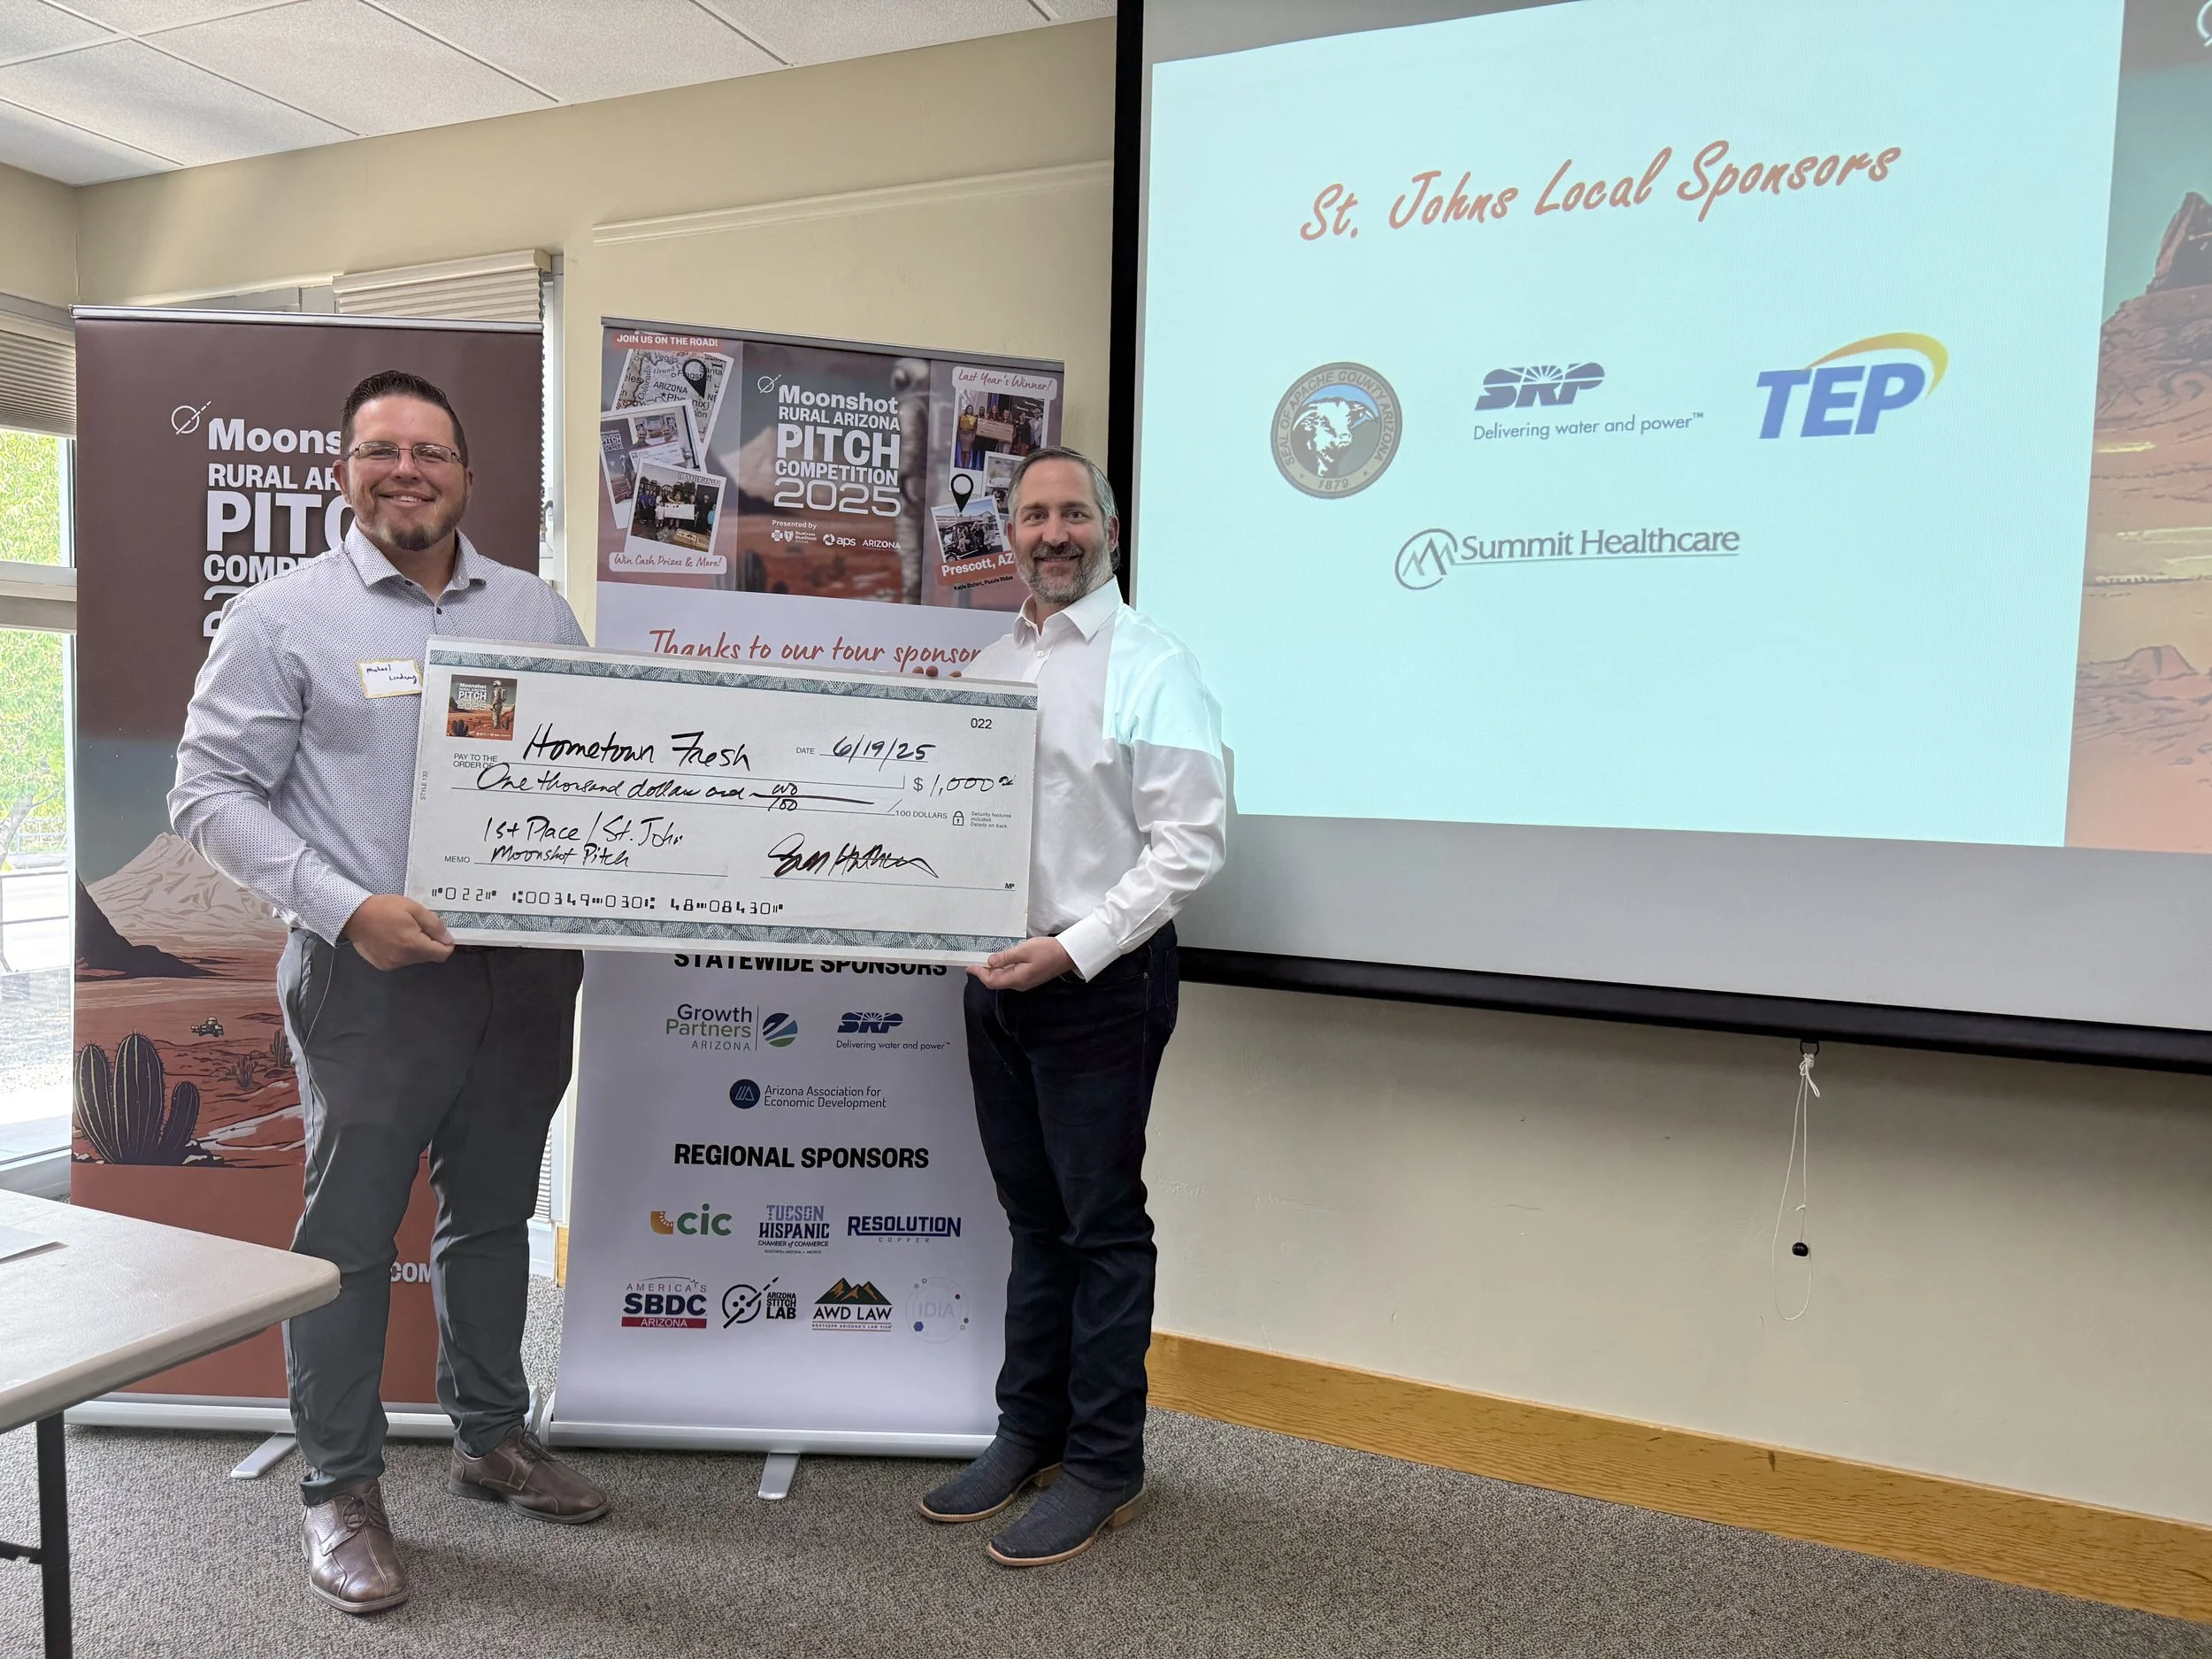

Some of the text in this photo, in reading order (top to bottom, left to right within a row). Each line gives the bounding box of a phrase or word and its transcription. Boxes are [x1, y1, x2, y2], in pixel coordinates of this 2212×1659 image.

[1300, 140, 1901, 241] St. Johns Local Sponsors
[617, 334, 639, 343] JOIN
[670, 337, 688, 346] THE
[689, 338, 718, 347] ROAD!
[653, 381, 688, 395] ARIZONA
[958, 369, 1052, 391] Last Year's Winner!
[1474, 362, 1605, 411] SRP
[779, 385, 899, 414] Moonshot
[1756, 363, 1925, 439] TEP
[779, 406, 901, 431] RURAL ARIZONA
[1279, 371, 1394, 466] SEAL OF APACHE COUNTY ARIZONA
[1474, 422, 1549, 441] Delivering
[1555, 420, 1600, 435] water
[1604, 414, 1635, 432] and
[208, 418, 342, 455] Moons
[777, 423, 901, 469] PITCH
[208, 463, 298, 489] RURAL
[775, 459, 898, 486] COMPETITION
[1317, 478, 1349, 490] 1879
[773, 477, 902, 517] 2025
[772, 520, 817, 530] Presented by
[836, 536, 856, 547] aps
[862, 539, 901, 549] ARIZONA
[1461, 527, 1740, 560] Summit Healthcare
[614, 554, 723, 567] Win Cash Prizes & More!
[941, 553, 1014, 577] Prescott, AZ
[649, 628, 981, 672] Thanks to our tour sponsor
[458, 691, 487, 701] PITCH
[971, 718, 993, 730] 022
[522, 723, 750, 772] Hometown Fresh
[833, 734, 936, 772] 6/19/25
[477, 763, 534, 791] One
[538, 770, 621, 796] thousand
[913, 777, 924, 793] $
[912, 810, 948, 819] DOLLARS
[526, 816, 581, 841] Place
[603, 814, 634, 841] St.
[491, 842, 629, 867] Moonshot Pitch
[674, 953, 948, 976] STATEWIDE SPONSORS
[677, 1003, 752, 1023] Growth
[837, 1012, 902, 1033] SRP
[666, 1018, 751, 1038] Partners
[691, 1041, 750, 1051] ARIZONA
[836, 1040, 876, 1050] Delivering
[902, 1041, 918, 1049] and
[764, 1085, 881, 1097] Arizona Association for
[764, 1095, 887, 1110] Economic Development
[674, 1143, 929, 1169] REGIONAL SPONSORS
[677, 1203, 733, 1236] cic
[766, 1204, 825, 1222] TUCSON
[758, 1222, 830, 1240] HISPANIC
[847, 1216, 962, 1238] RESOLUTION
[787, 1240, 794, 1248] of
[626, 1283, 707, 1293] AMERICA'S
[623, 1293, 707, 1316] SBDC
[766, 1307, 796, 1319] LAB
[767, 1298, 796, 1307] STITCH
[641, 1318, 687, 1327] ARIZONA
[813, 1306, 892, 1321] AWD LAW
